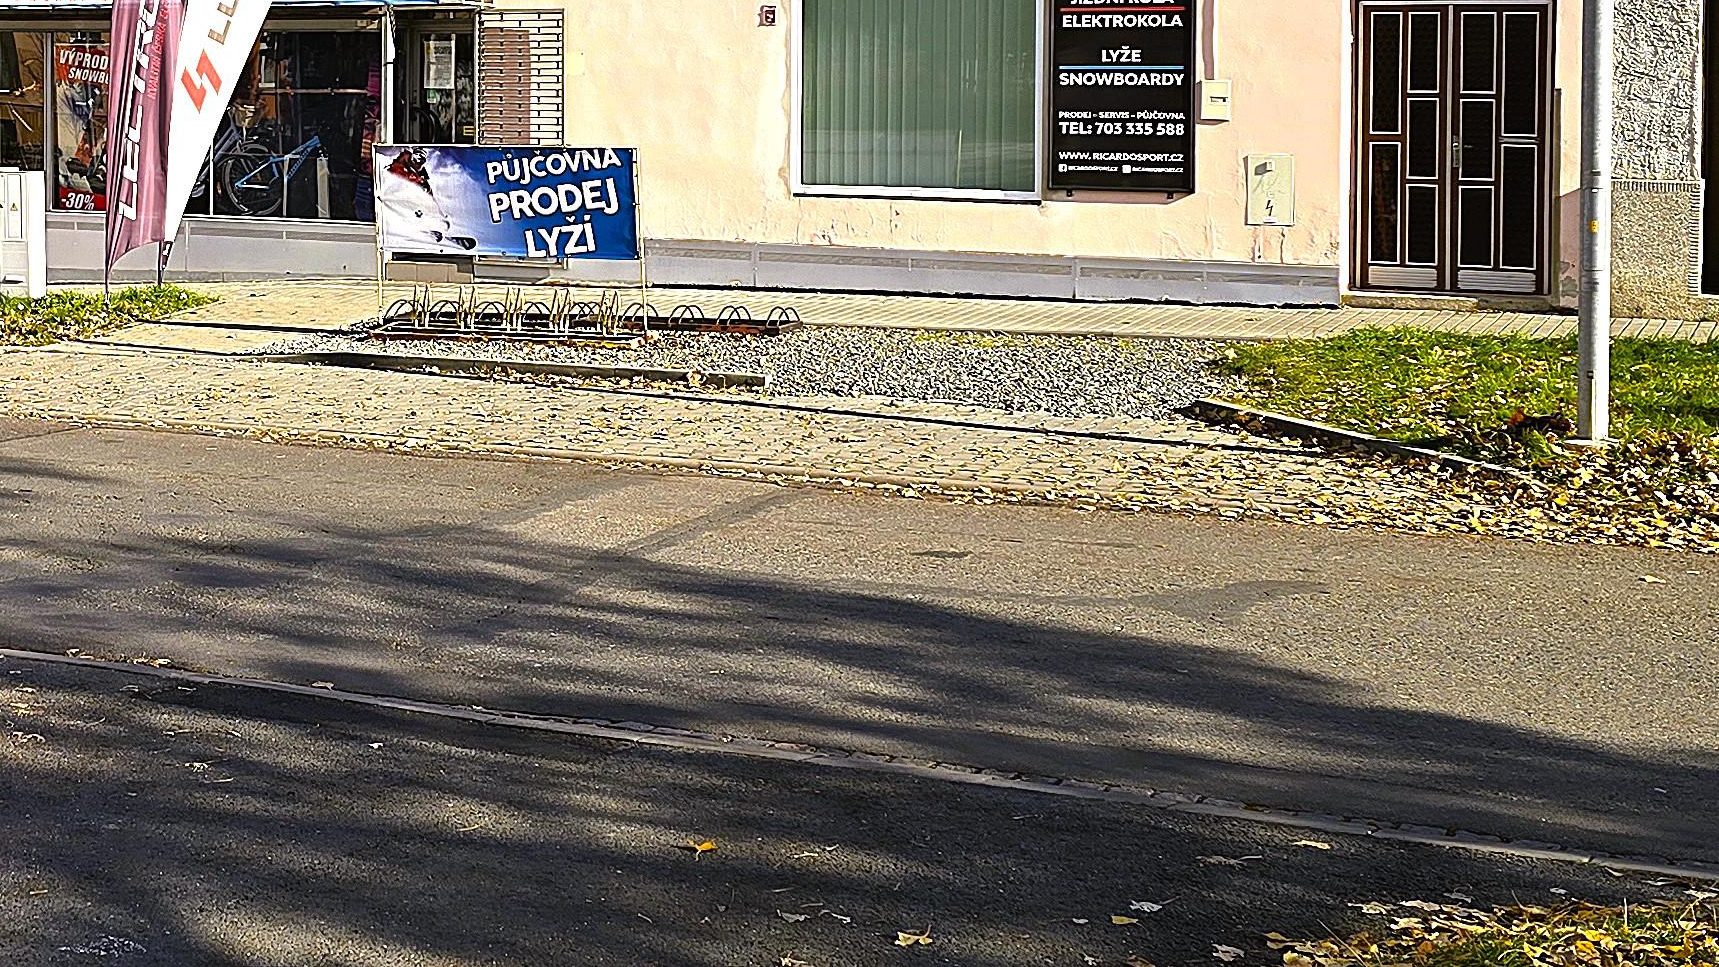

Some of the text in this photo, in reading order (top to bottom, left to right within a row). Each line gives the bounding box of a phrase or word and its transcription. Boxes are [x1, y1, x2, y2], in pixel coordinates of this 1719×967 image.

[1062, 14, 1183, 27] ELEKTROKOLA
[59, 49, 109, 70] VÝPROD
[1101, 46, 1142, 63] LYŽE
[1058, 73, 1185, 86] SNOWBOARDY
[1058, 121, 1185, 136] TEL: 703 335 588
[486, 148, 622, 185] PŮJČOVNA
[488, 177, 620, 223] PRODEJ
[524, 214, 596, 259] LYŽÍ
